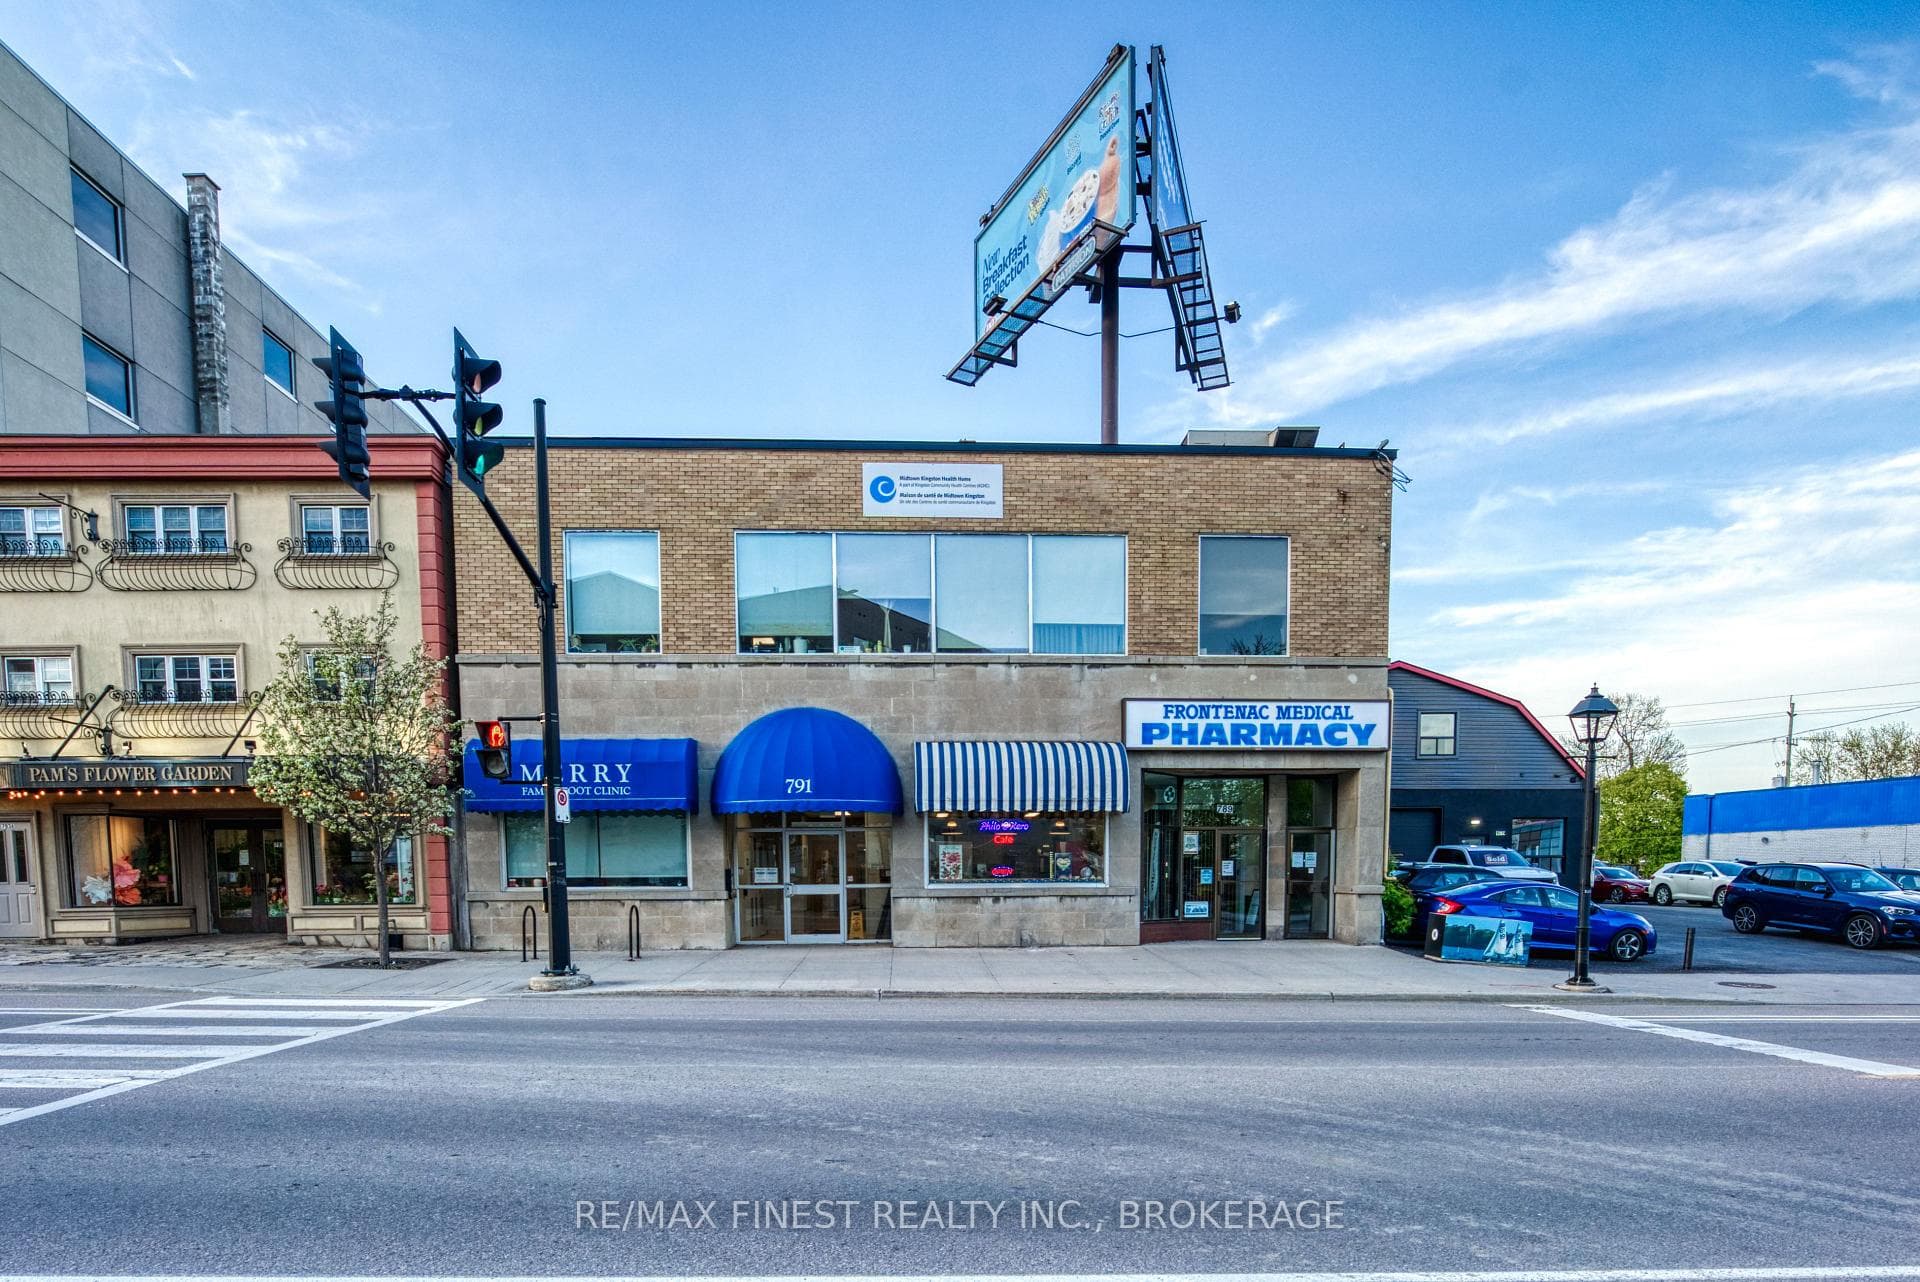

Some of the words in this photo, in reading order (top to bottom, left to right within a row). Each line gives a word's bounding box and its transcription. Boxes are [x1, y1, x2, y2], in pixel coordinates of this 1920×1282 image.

[982, 234, 1028, 294] Breakfast
[982, 252, 1030, 306] Collection
[1162, 704, 1269, 720] FRONTENAC
[1275, 705, 1354, 721] MEDICAL
[1141, 722, 1377, 747] PHARMACY
[29, 766, 79, 782] PAM'S
[84, 766, 157, 782] FLOWER
[161, 765, 233, 782] GARDEN
[519, 763, 633, 783] MRRY
[566, 786, 592, 795] OOT
[594, 786, 631, 795] CLINIC
[785, 778, 813, 794] 791
[1217, 804, 1234, 813] 789
[979, 820, 1001, 832] Philo
